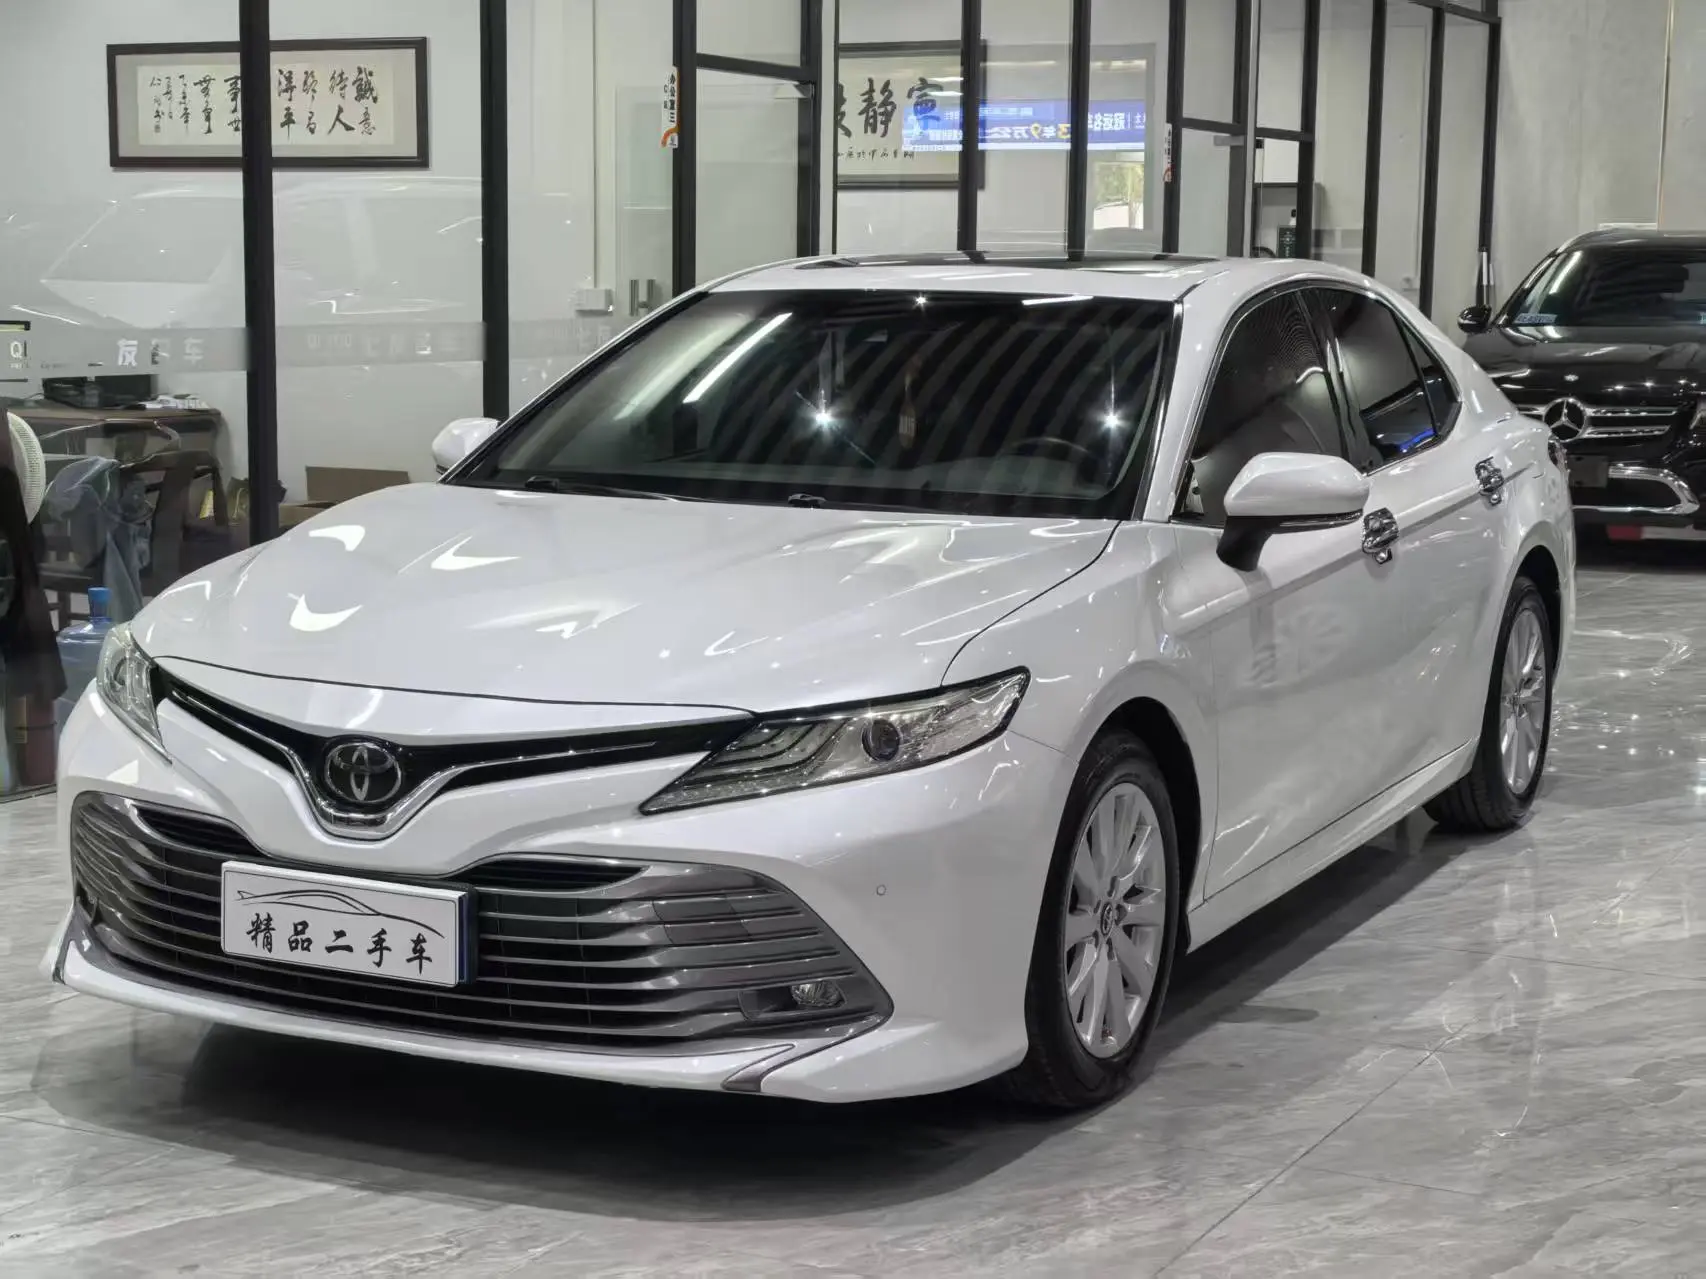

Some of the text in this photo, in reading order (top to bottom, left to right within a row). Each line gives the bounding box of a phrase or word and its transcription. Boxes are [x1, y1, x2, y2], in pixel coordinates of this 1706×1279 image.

[246, 912, 433, 975] 精品二手车
